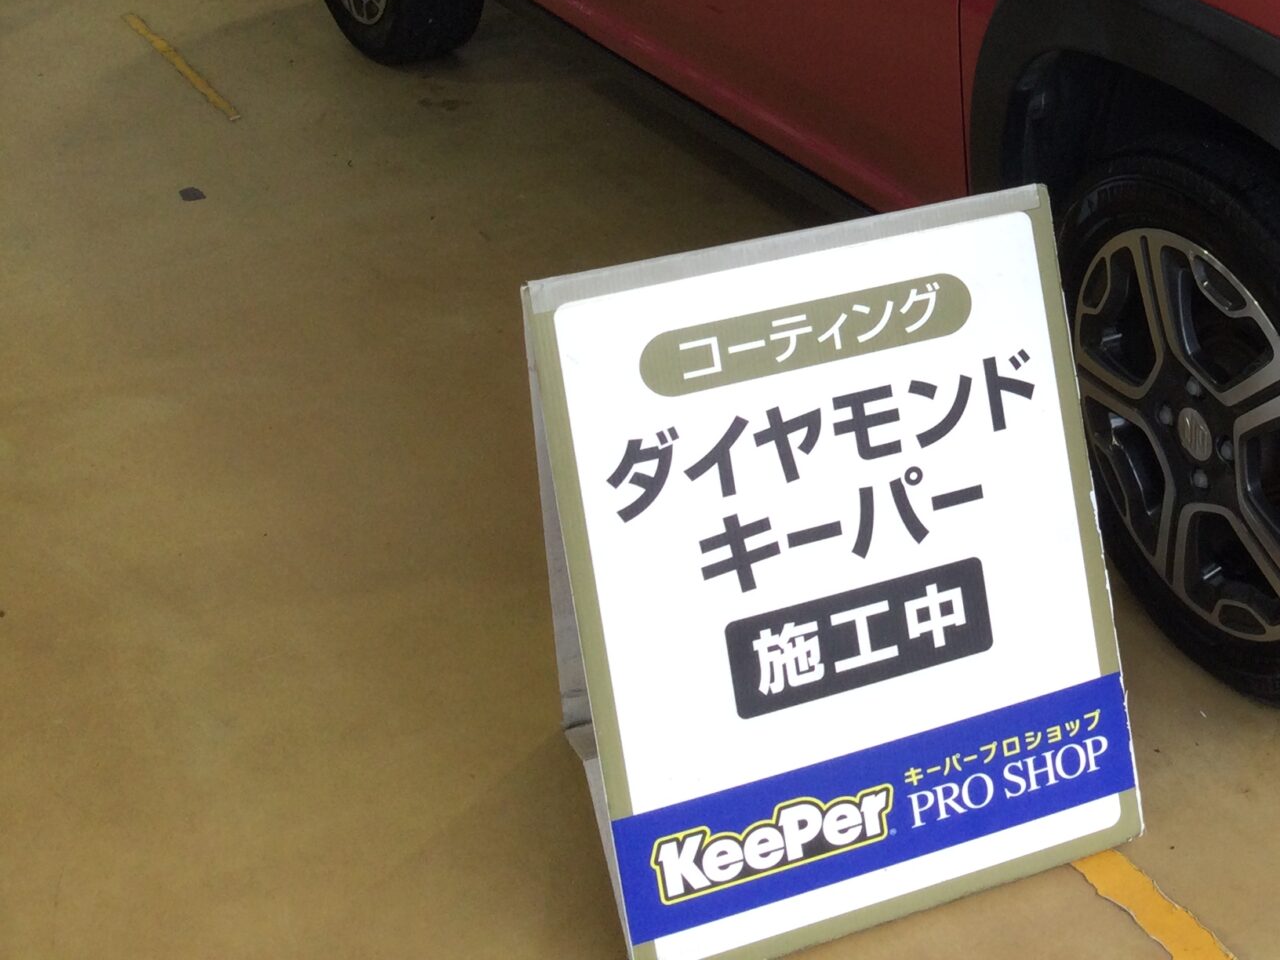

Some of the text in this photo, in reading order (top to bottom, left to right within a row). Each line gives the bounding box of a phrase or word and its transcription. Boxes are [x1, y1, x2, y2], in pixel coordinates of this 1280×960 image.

[679, 282, 941, 381] コーティング
[606, 348, 1036, 524] ダイヤモンド
[699, 465, 984, 593] キーパー
[752, 583, 967, 697] 施工中
[904, 708, 1102, 787] キーパープロショップ
[907, 735, 1109, 830] PRO SHOP
[653, 785, 893, 903] KeePer
